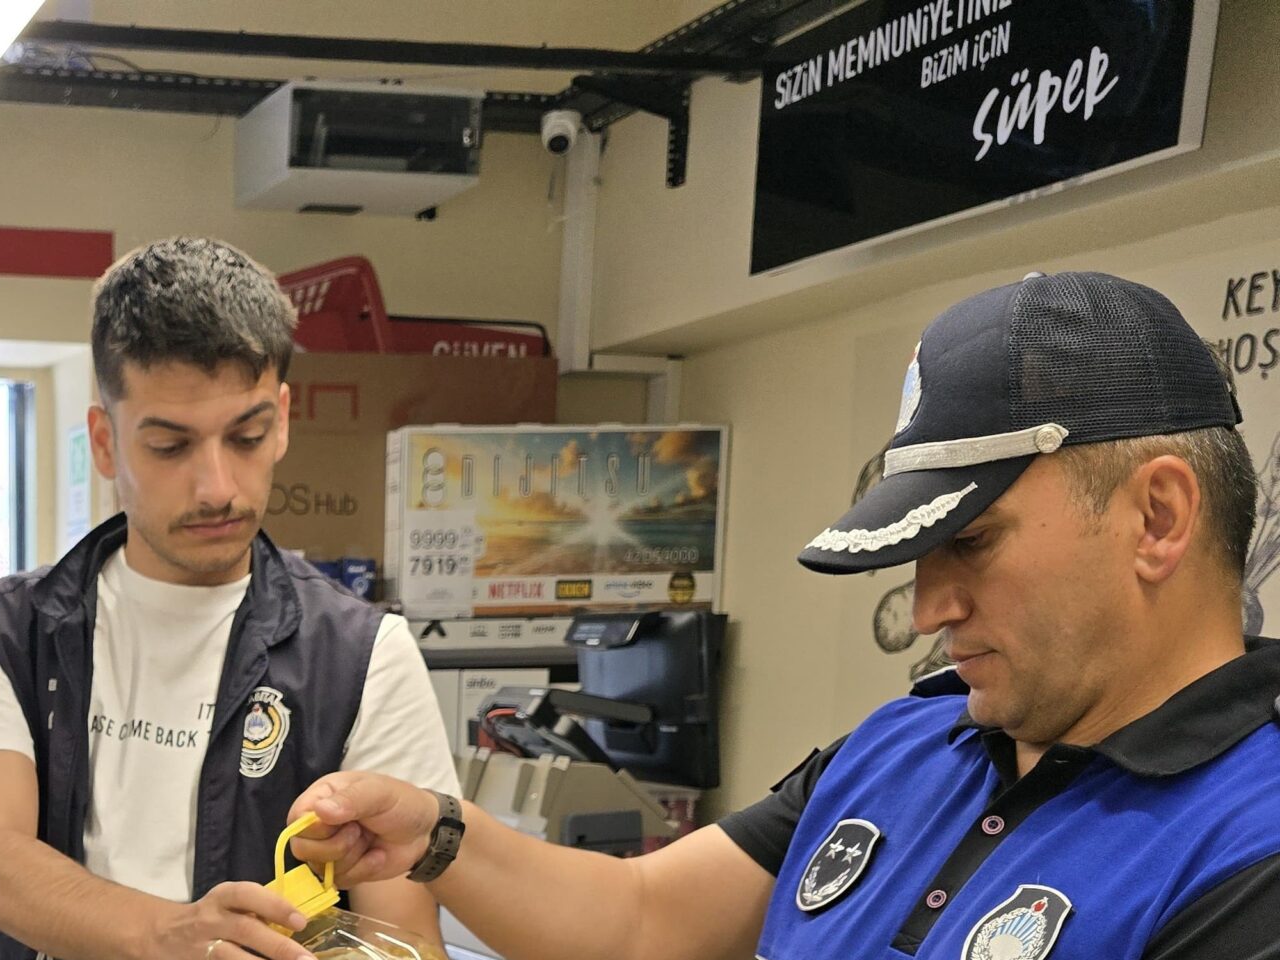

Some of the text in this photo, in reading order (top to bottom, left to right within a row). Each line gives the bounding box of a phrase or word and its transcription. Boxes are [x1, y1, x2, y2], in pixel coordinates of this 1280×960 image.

[920, 20, 1012, 88] BİZİM İÇİN
[774, 54, 822, 110] SİZİN
[313, 491, 359, 516] Hub
[488, 581, 544, 599] NETFLIX
[155, 726, 198, 748] BACK
